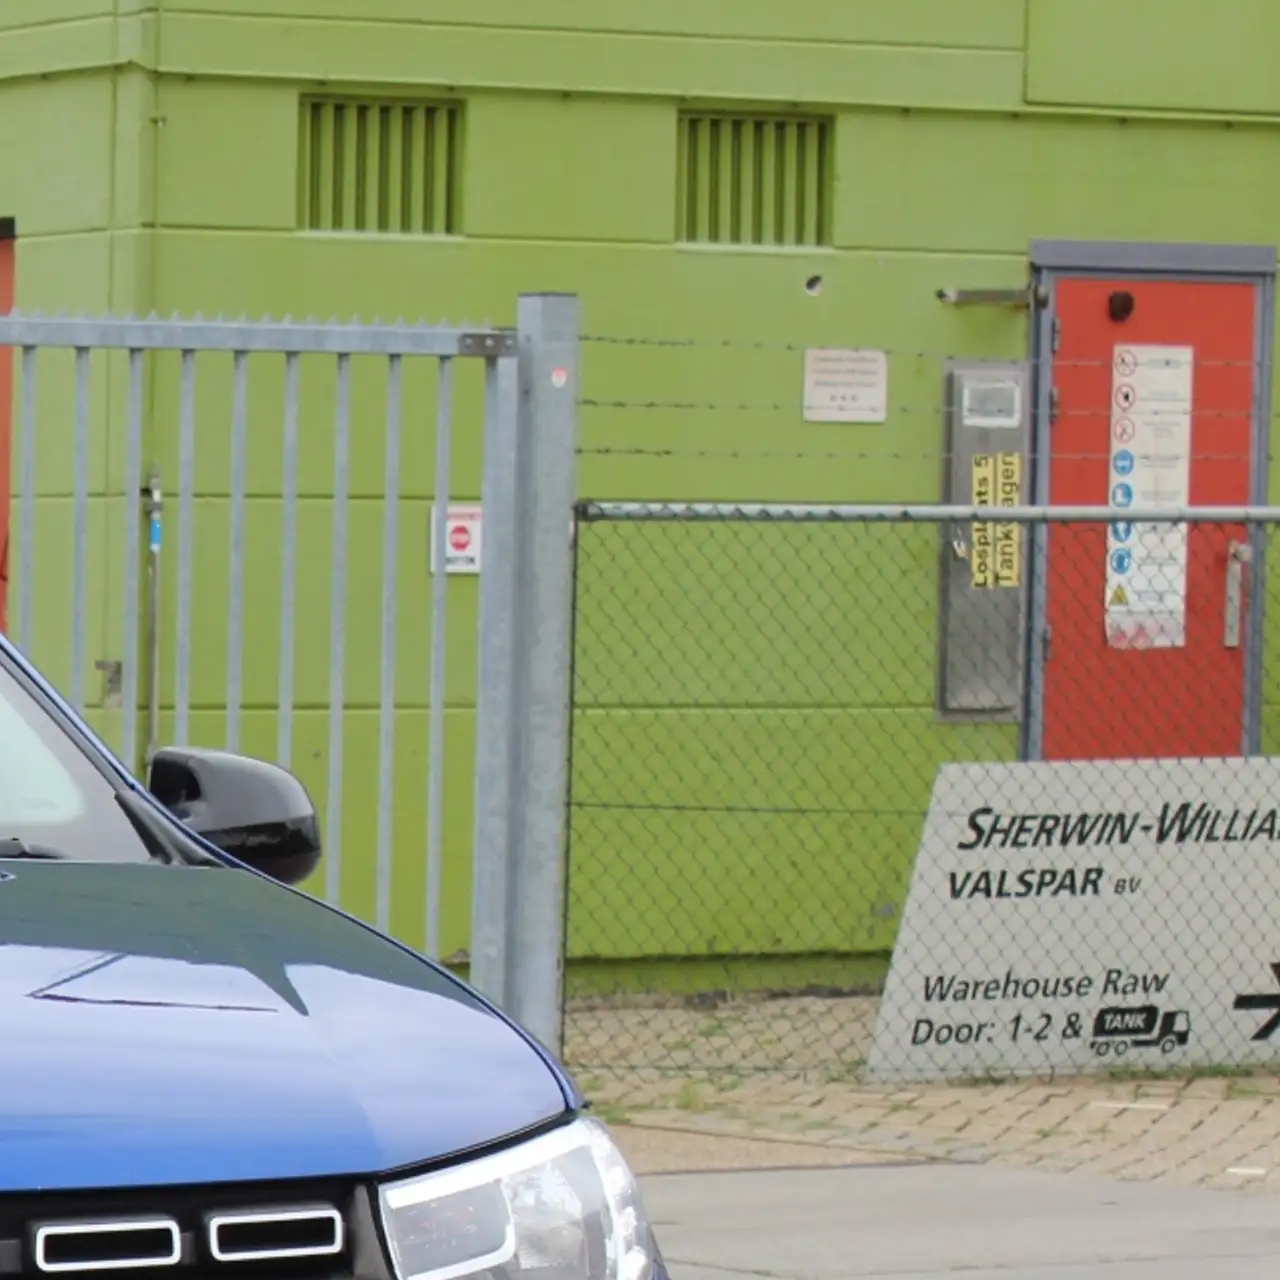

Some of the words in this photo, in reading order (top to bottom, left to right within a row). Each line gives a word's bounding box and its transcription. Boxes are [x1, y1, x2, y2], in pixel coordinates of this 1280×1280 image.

[974, 456, 989, 468] 5
[974, 476, 991, 588] Losplts
[995, 453, 1019, 585] Tankagen
[957, 802, 1280, 850] SHERWIN-WILLIA
[950, 867, 1104, 899] VALSPAR
[924, 966, 1093, 1001] Warehouse
[1103, 969, 1169, 997] Raw
[911, 1018, 995, 1045] Door:
[1010, 1012, 1052, 1042] 1-2
[1062, 1012, 1083, 1039] &
[1103, 1011, 1148, 1030] TANK
